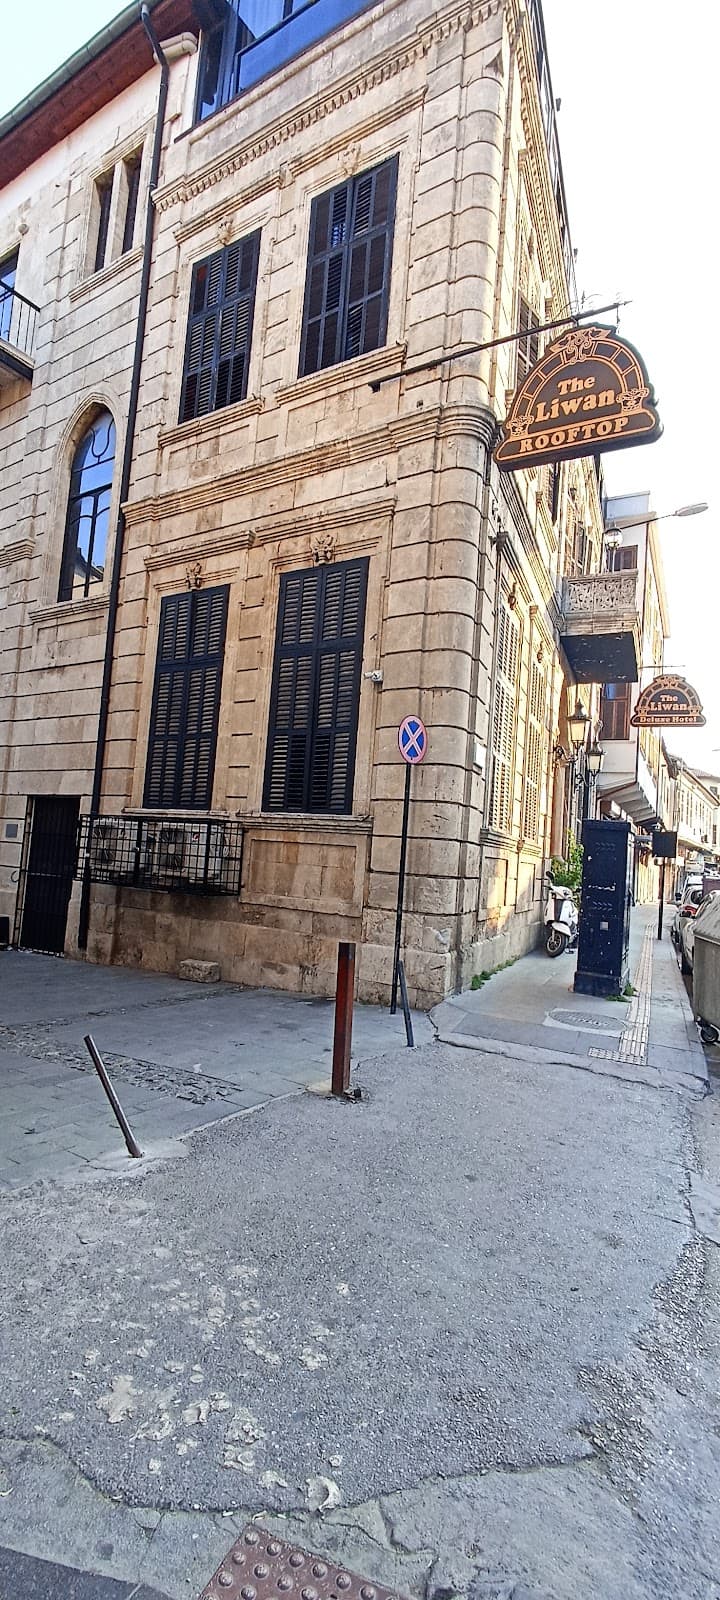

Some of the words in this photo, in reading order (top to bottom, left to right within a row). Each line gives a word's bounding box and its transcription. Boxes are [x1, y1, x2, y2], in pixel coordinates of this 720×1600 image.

[557, 376, 595, 395] The
[535, 389, 615, 422] Liwan
[519, 417, 629, 453] ROOFTOP
[650, 702, 687, 711] Liwan
[660, 694, 678, 702] The
